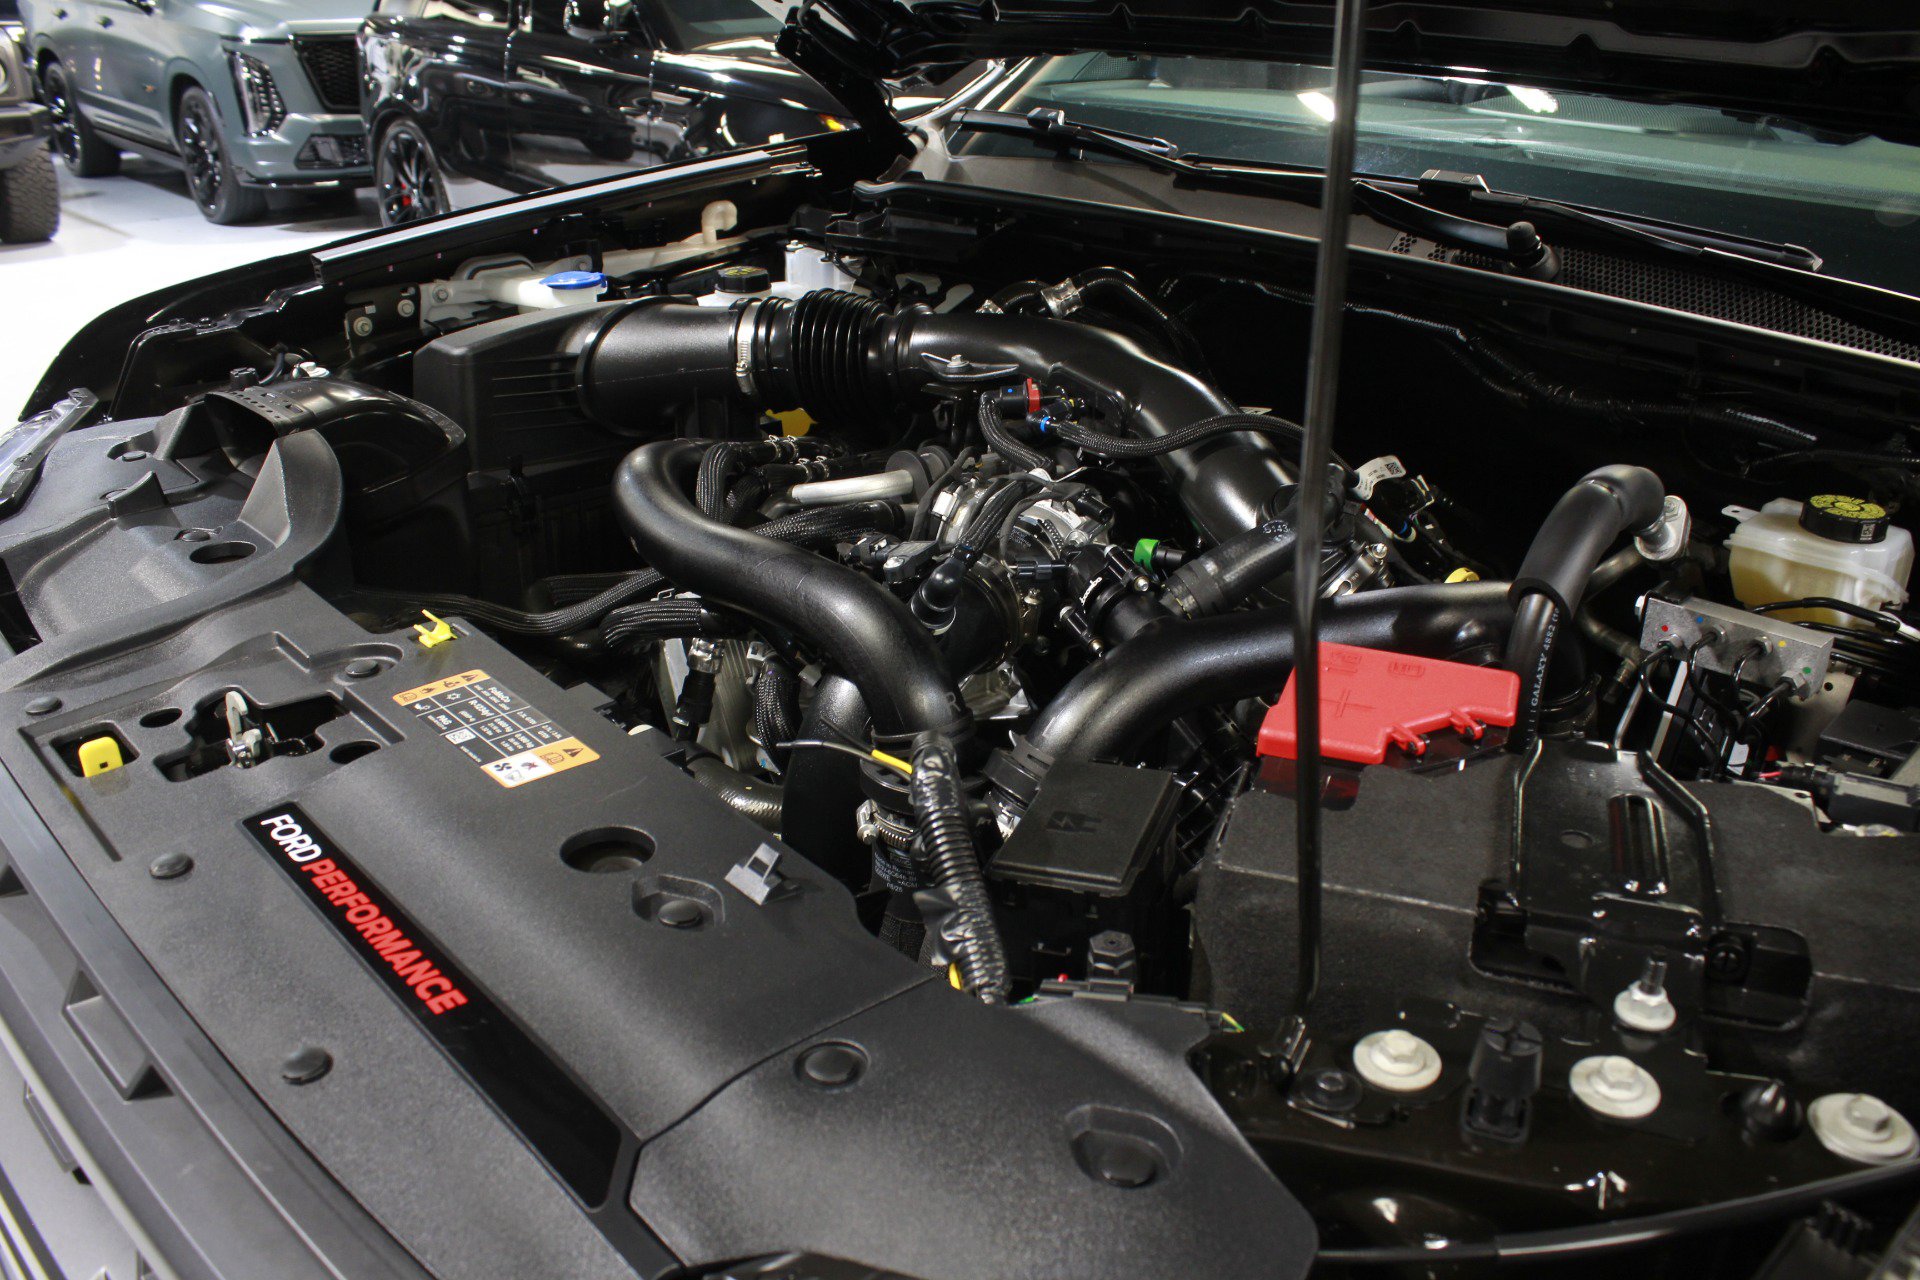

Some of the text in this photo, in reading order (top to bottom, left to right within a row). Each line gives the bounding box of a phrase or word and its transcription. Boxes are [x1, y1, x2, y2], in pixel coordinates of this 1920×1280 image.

[1530, 653, 1548, 706] GALAXY
[1544, 625, 1556, 651] 4882
[437, 714, 453, 725] PAG
[260, 813, 469, 1015] FORD PERFORMANCE
